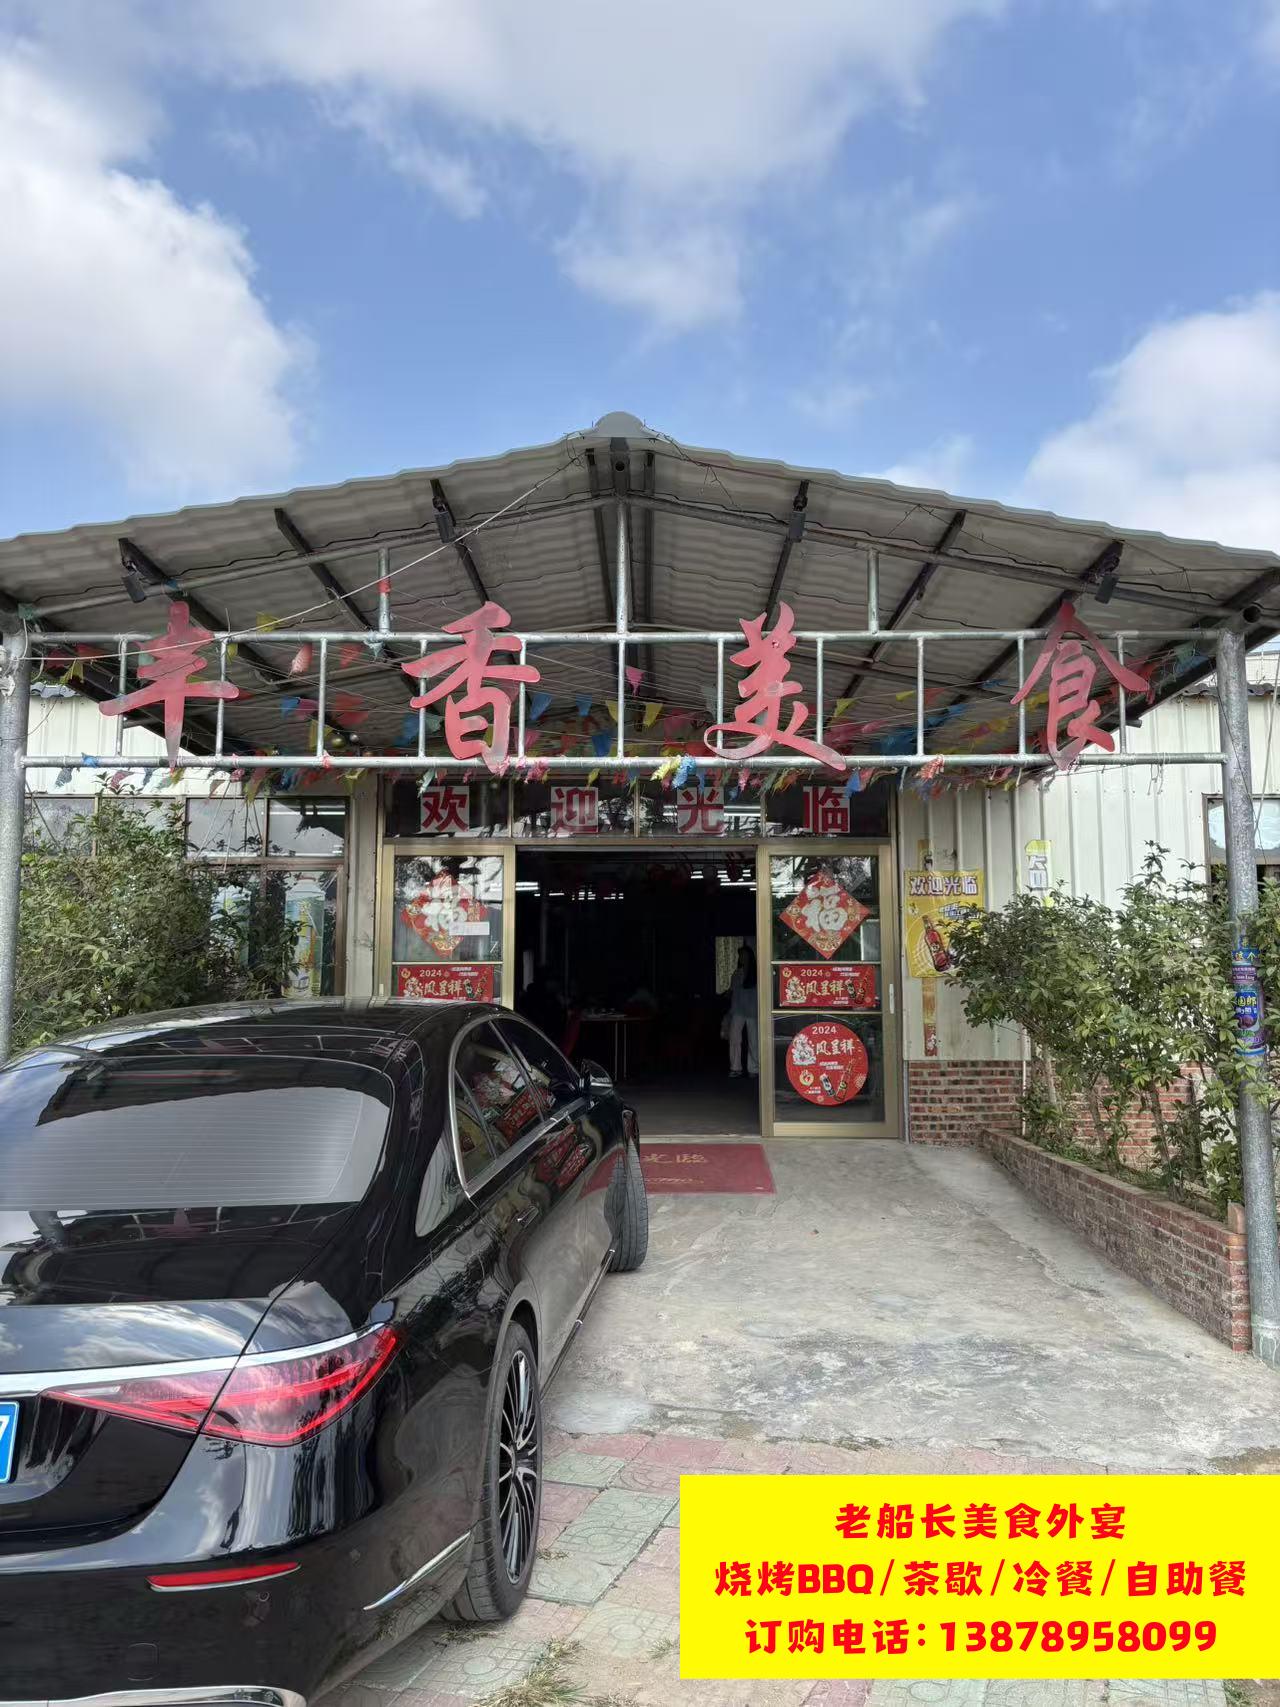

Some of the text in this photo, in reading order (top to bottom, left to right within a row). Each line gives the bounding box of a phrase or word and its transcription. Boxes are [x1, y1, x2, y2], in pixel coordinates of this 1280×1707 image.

[421, 785, 850, 835] 欢迎光临
[909, 875, 979, 897] 欢迎光临
[801, 884, 849, 932] 福
[419, 969, 443, 978] 2024
[800, 968, 824, 978] 2024
[811, 1025, 838, 1035] 2024
